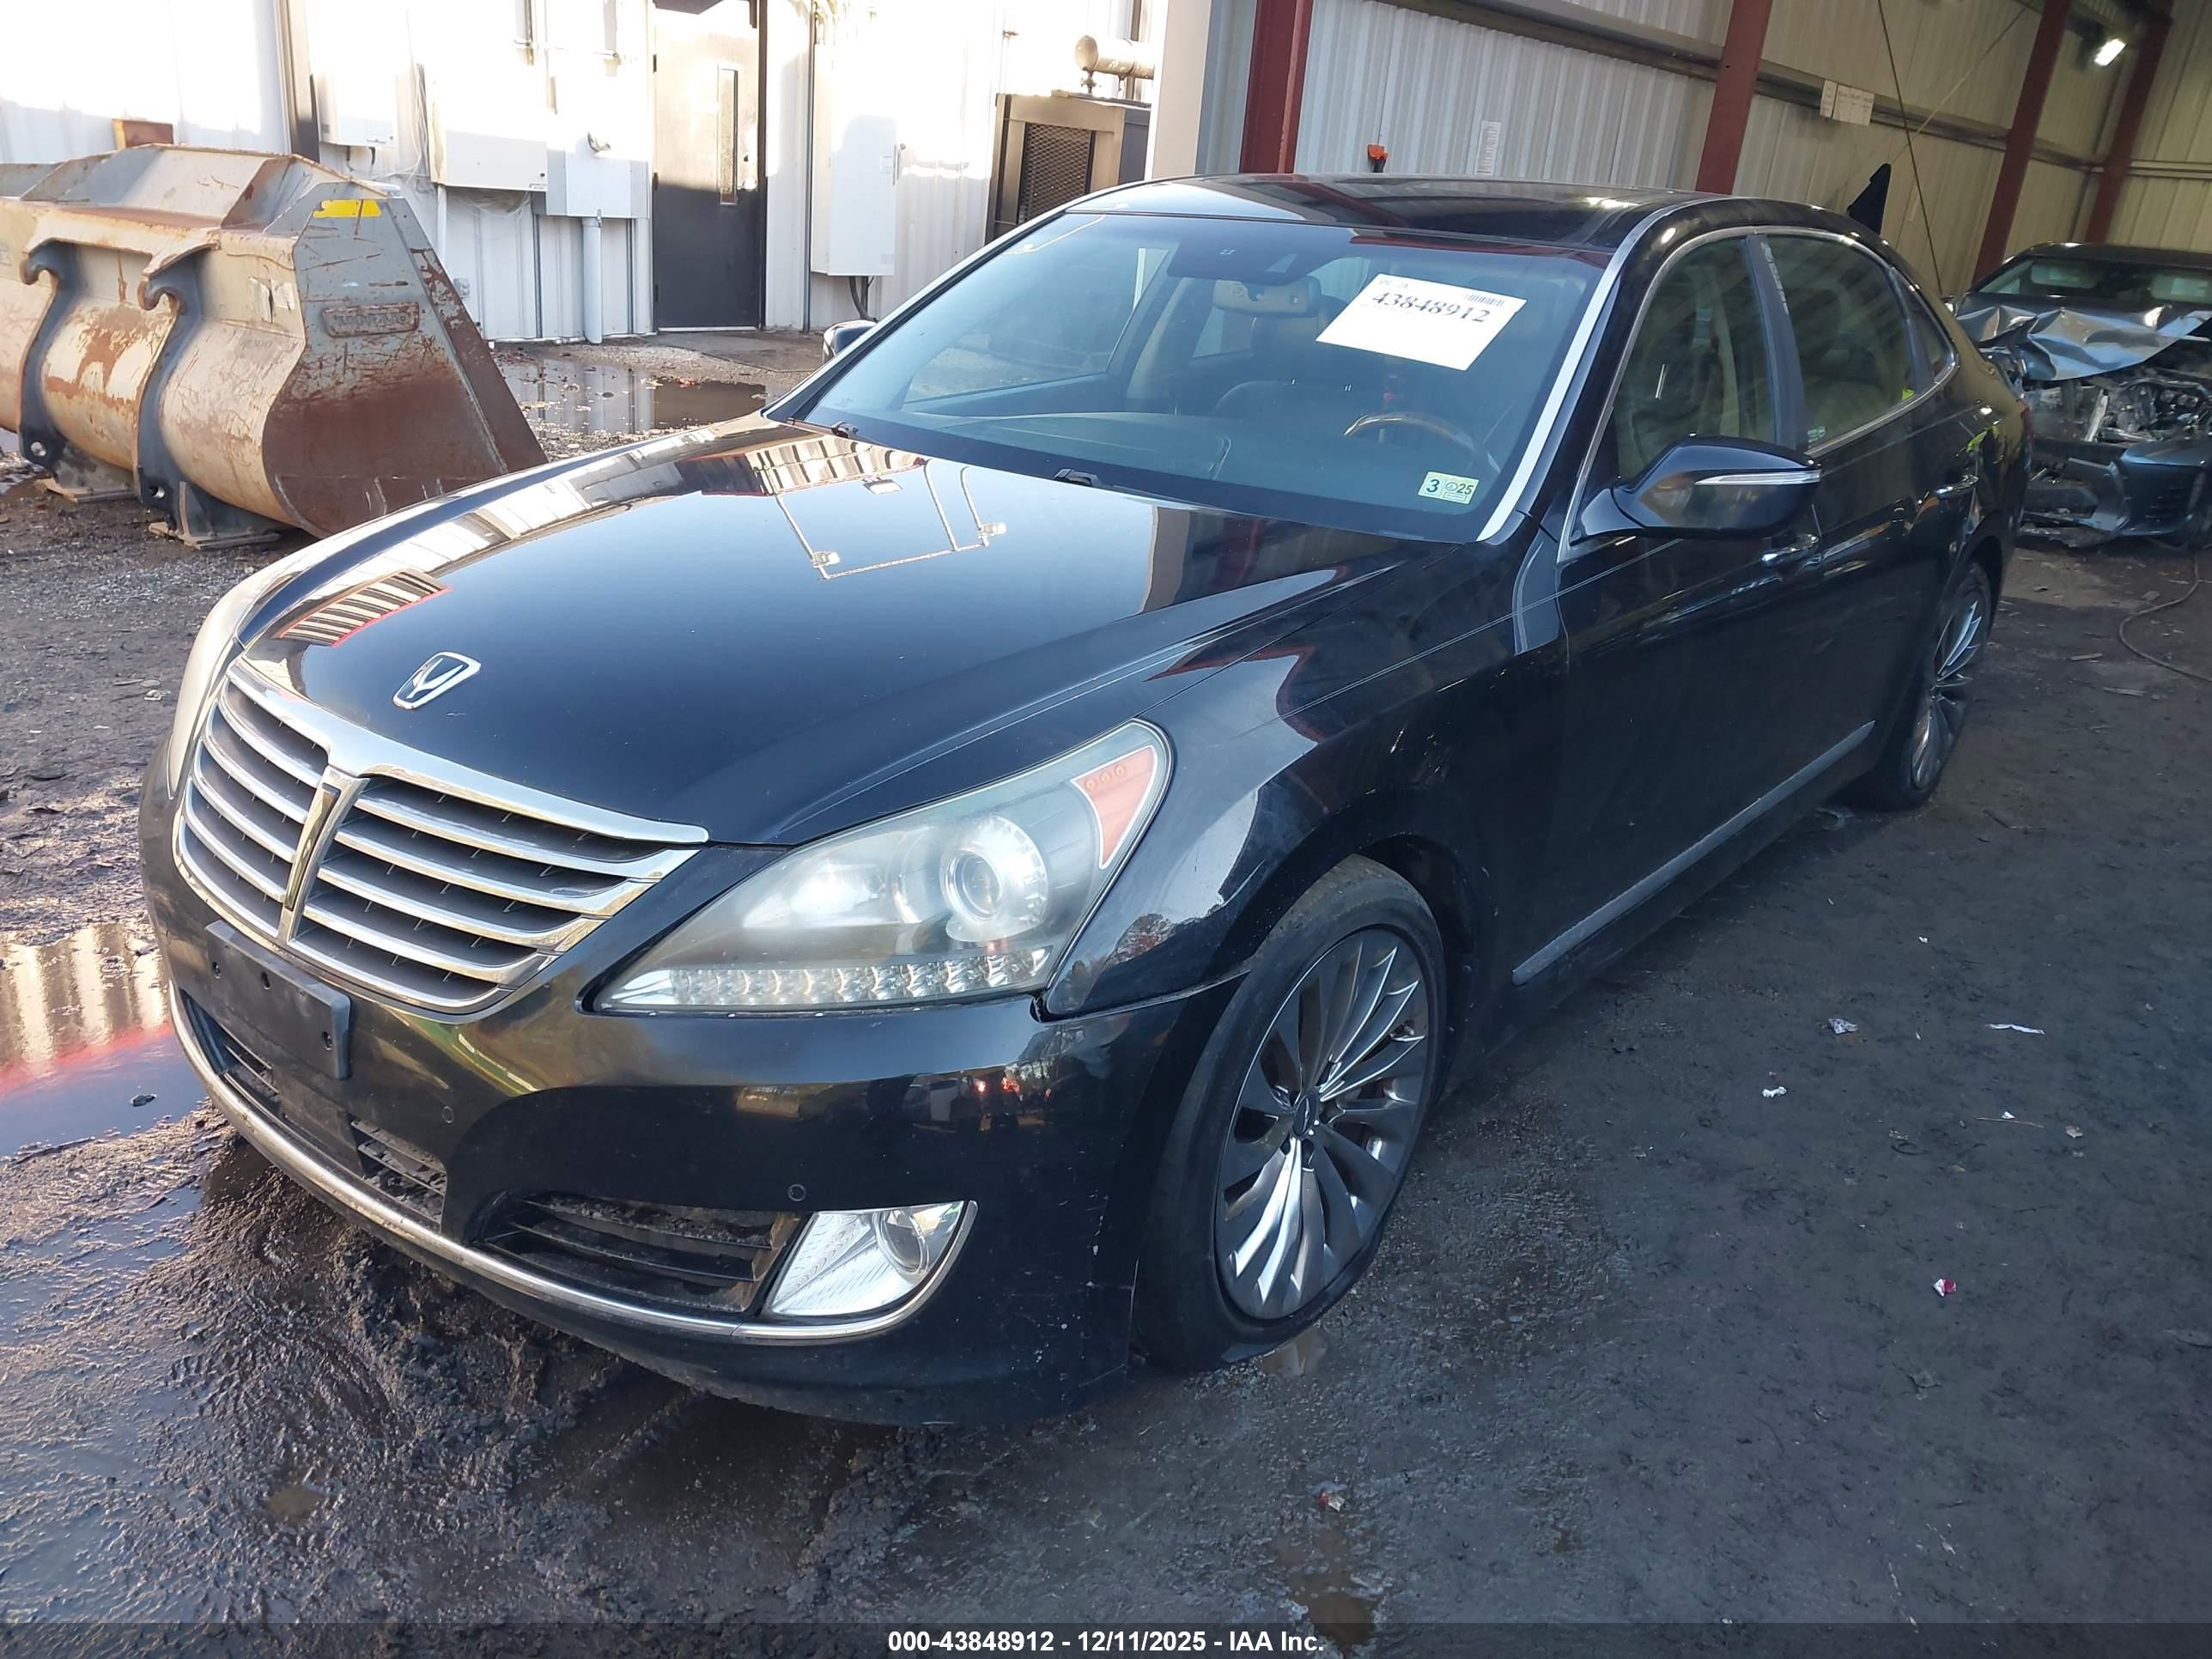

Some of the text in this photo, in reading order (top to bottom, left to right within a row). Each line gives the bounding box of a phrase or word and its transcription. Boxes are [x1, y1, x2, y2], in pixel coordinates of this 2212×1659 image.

[1372, 292, 1491, 323] 43848912
[1426, 479, 1474, 495] 3 25
